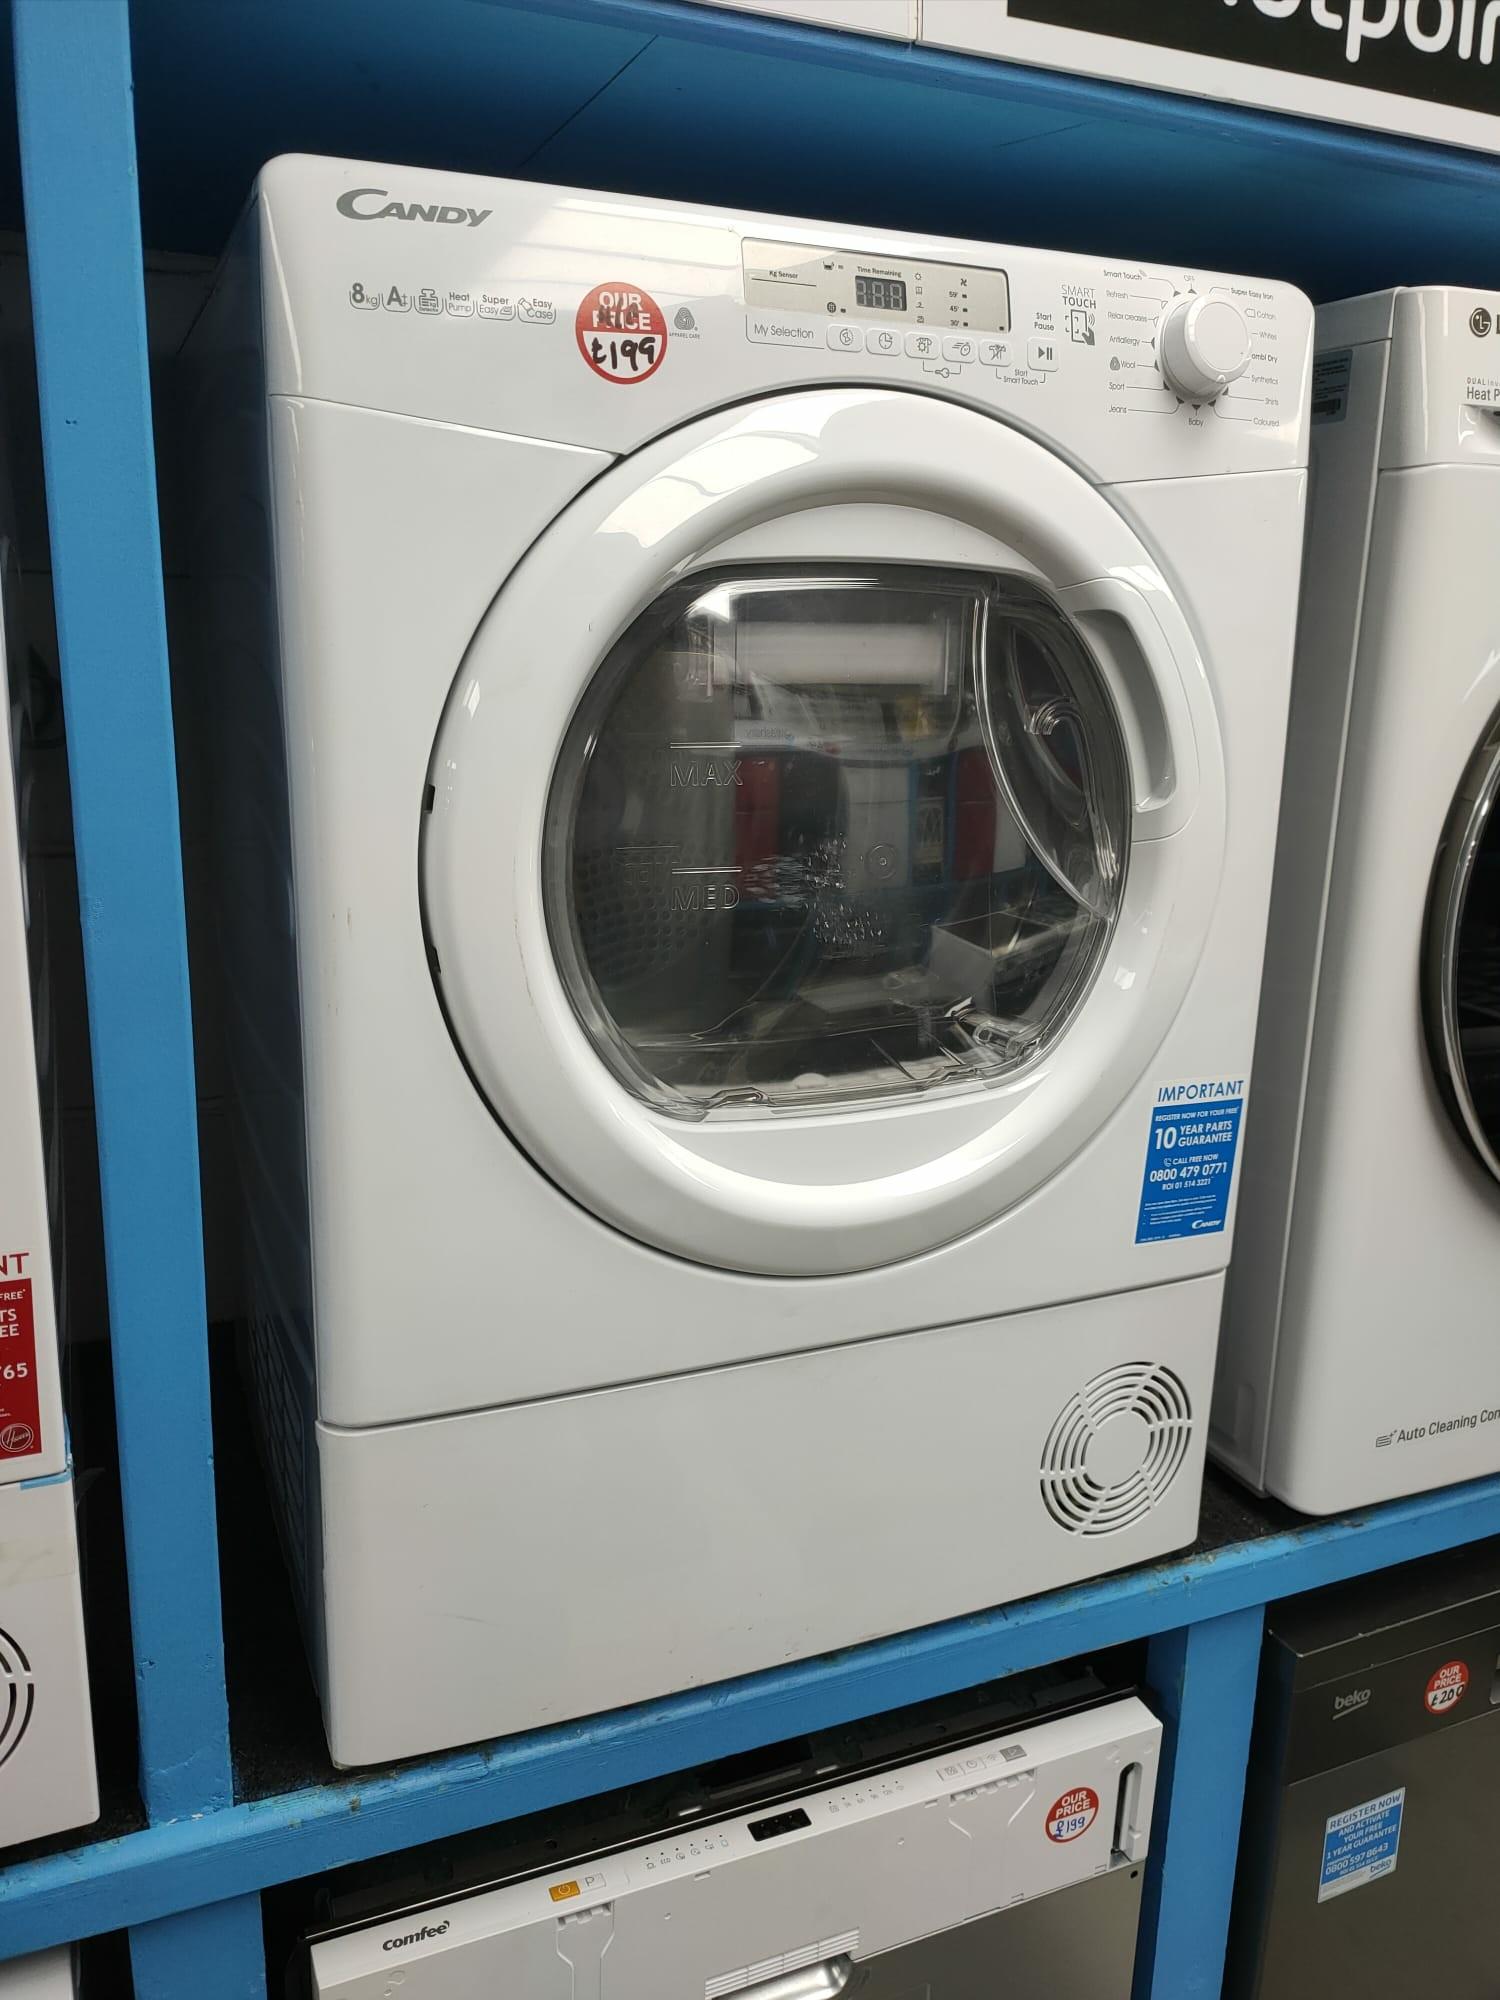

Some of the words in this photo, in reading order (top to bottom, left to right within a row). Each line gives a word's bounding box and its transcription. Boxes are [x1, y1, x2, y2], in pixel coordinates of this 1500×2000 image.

[336, 188, 493, 227] CANDY
[778, 270, 798, 279] Sensor
[857, 266, 871, 274] Time
[872, 267, 902, 278] Remaining
[449, 292, 470, 302] Heat
[1061, 284, 1097, 299] SMART
[482, 294, 509, 306] Super
[533, 298, 553, 309] Easy
[599, 291, 644, 311] OUR
[1062, 295, 1097, 309] TOUCH
[449, 302, 472, 313] Pump
[480, 304, 499, 316] Easy
[527, 308, 554, 319] Case
[1036, 312, 1052, 321] Start
[754, 323, 769, 337] My
[770, 325, 814, 339] Selection
[1033, 321, 1055, 331] Pause
[1120, 360, 1136, 369] Wool
[1251, 352, 1267, 361] ombi
[1268, 355, 1278, 363] Dry
[1014, 368, 1028, 377] Start
[1003, 376, 1021, 384] Smart
[1021, 377, 1039, 386] Touch
[1109, 381, 1125, 391] Sport
[1467, 386, 1491, 401] Heat
[1108, 405, 1127, 414] Jeans
[670, 760, 744, 787] MAX
[671, 884, 740, 910] MED
[1157, 1080, 1244, 1103] IMPORTANT
[1155, 1113, 1181, 1122] REGISTER
[1181, 1112, 1197, 1120] NOW
[1180, 1123, 1204, 1135] YEAR
[1205, 1120, 1233, 1132] PARTS
[1155, 1126, 1177, 1150] 10
[1178, 1132, 1233, 1147] GUARANTEE
[1172, 1157, 1188, 1165] CALL
[1189, 1155, 1203, 1163] FREE
[1203, 1153, 1219, 1161] NOW
[1150, 1168, 1178, 1182] 0800
[1179, 1165, 1200, 1178] 479
[1202, 1162, 1228, 1176] 0771
[0, 1362, 28, 1380] 65
[1397, 1427, 1426, 1443] Auto
[1428, 1415, 1478, 1436] Cleaning
[1440, 1665, 1460, 1679] OUR
[1434, 1673, 1463, 1690] PRICE
[1334, 1689, 1372, 1710] beko
[1061, 1790, 1088, 1807] OUR
[1055, 1798, 1091, 1819] PRICE
[1329, 1804, 1376, 1830] REGISTER
[1377, 1792, 1401, 1809] NOW
[1055, 1816, 1086, 1837] £199
[1338, 1825, 1355, 1838] AND
[1333, 1842, 1353, 1857] YEAR
[1353, 1823, 1398, 1848] GUARANTEE
[1344, 1831, 1364, 1843] YOUR
[1325, 1859, 1349, 1875] 0800
[1349, 1851, 1366, 1865] 597
